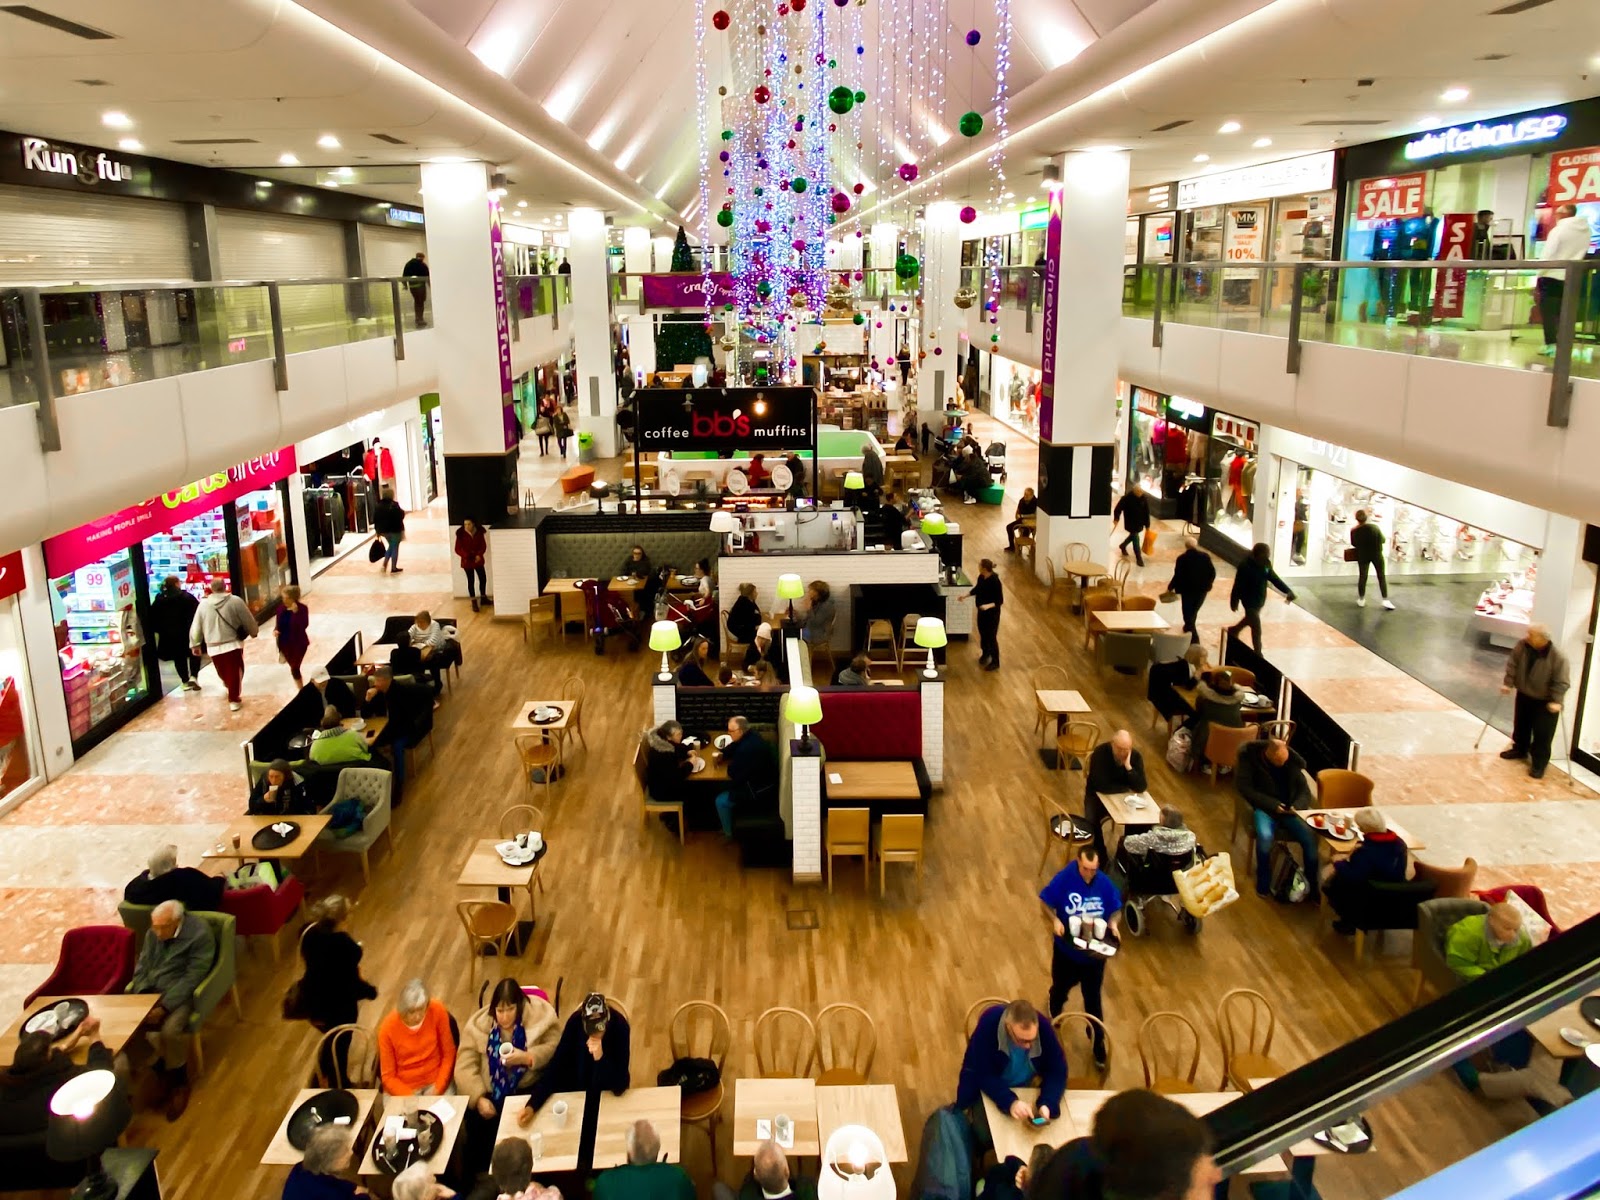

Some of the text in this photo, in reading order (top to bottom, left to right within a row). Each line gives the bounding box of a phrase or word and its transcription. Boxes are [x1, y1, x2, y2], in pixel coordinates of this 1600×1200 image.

[1405, 115, 1567, 160] whitehouse
[1236, 212, 1257, 222] MM
[1362, 187, 1421, 218] SALE
[1227, 248, 1255, 260] 10%
[1442, 222, 1467, 309] SALE
[1044, 258, 1056, 374] cineworld
[644, 426, 690, 439] coffee
[753, 425, 807, 437] muffins
[1216, 417, 1255, 442] SALE
[86, 510, 153, 543] MAKING PEOPLE SMILE
